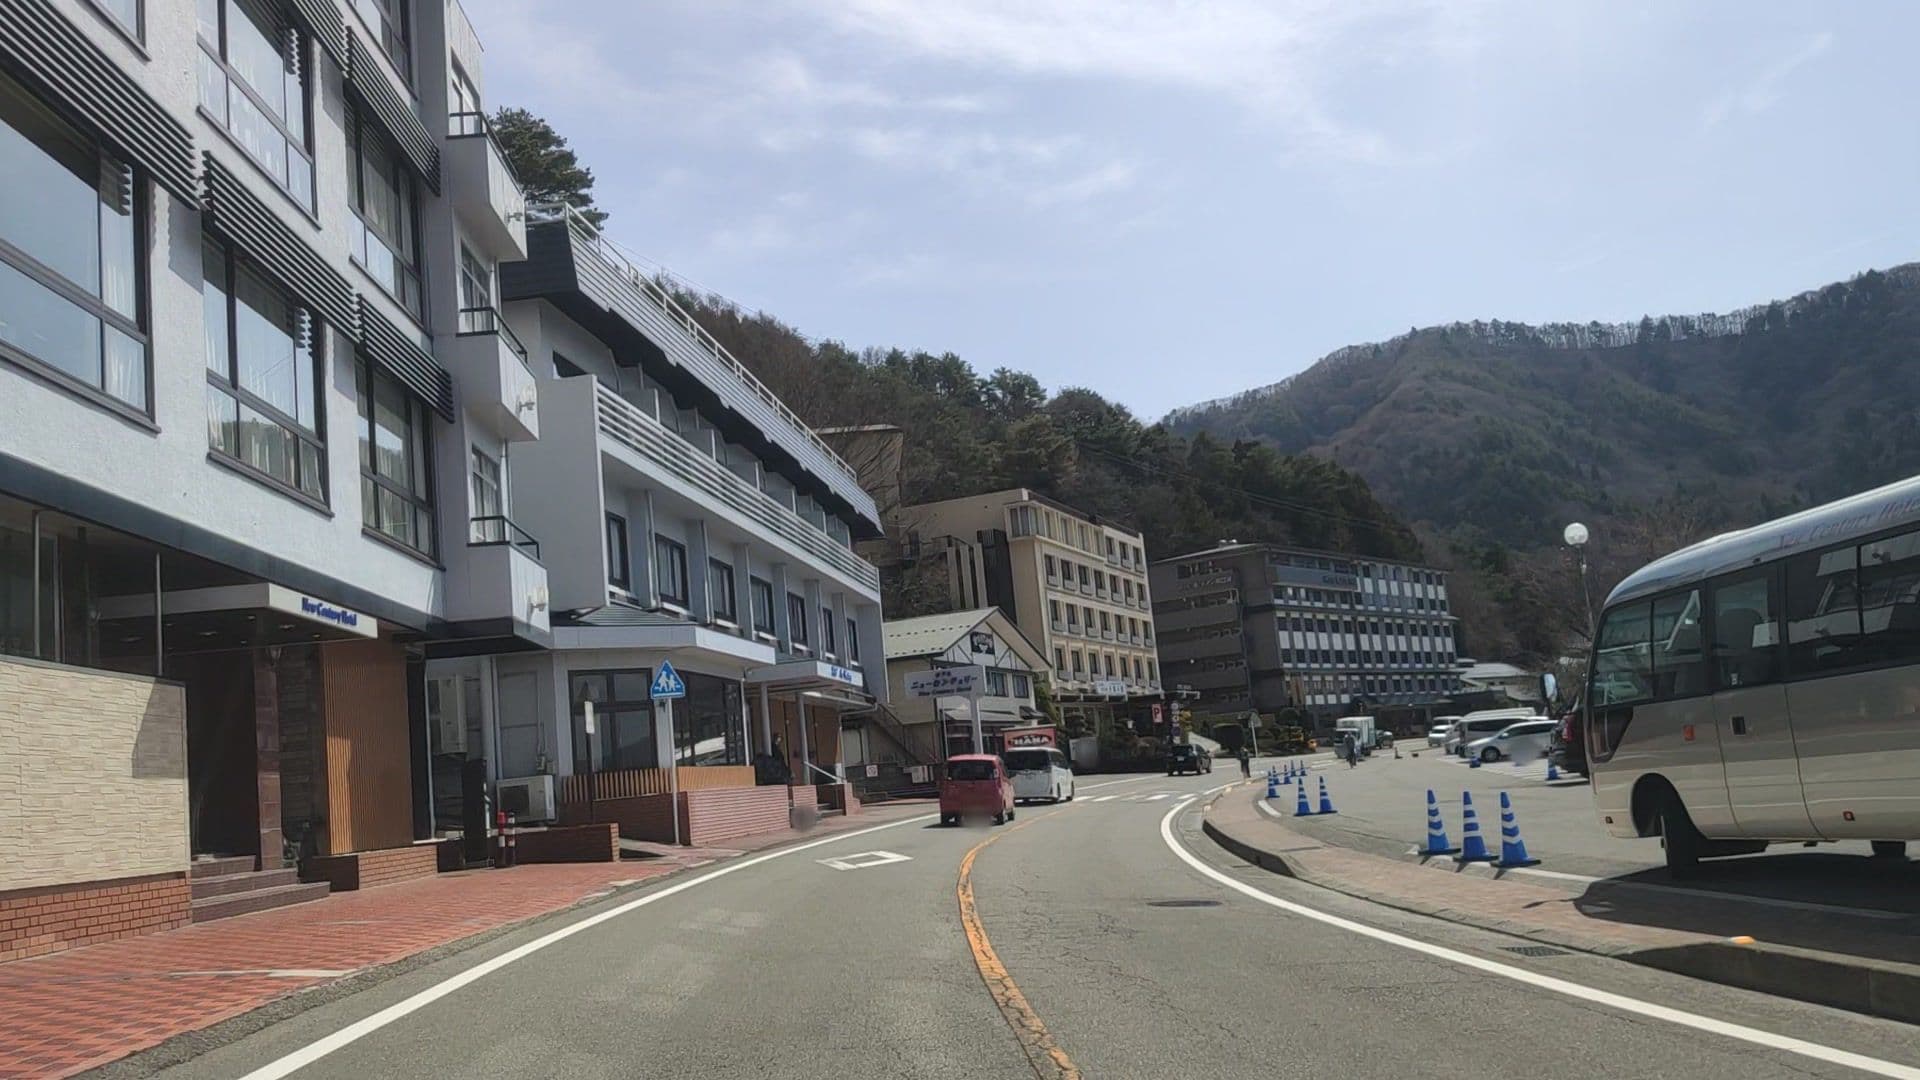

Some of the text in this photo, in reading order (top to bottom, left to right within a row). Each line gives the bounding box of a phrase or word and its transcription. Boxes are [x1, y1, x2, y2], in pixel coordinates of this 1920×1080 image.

[302, 596, 357, 626] New Century Hotel
[911, 675, 978, 689] ニューセンチュリー
